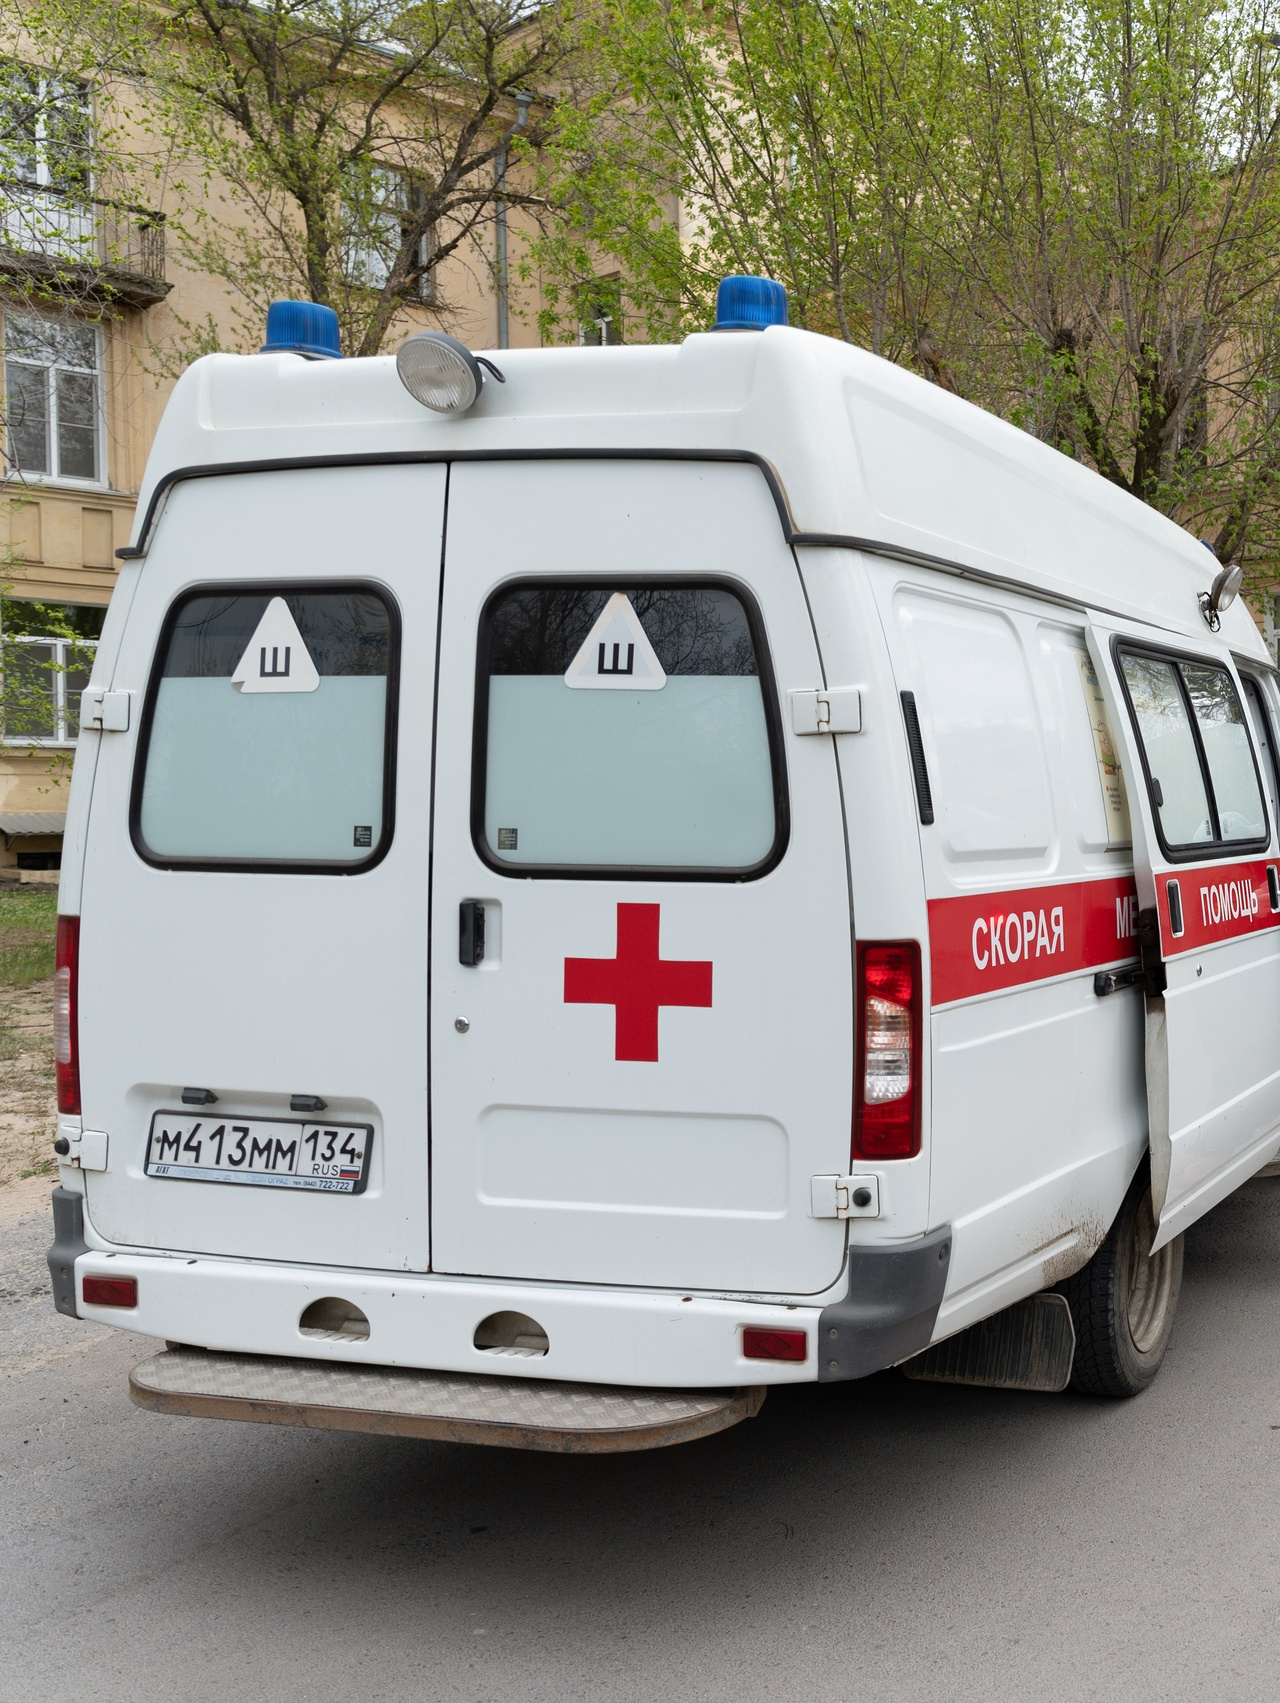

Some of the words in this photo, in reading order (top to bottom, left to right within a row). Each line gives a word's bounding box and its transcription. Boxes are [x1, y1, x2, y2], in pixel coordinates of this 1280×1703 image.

[259, 647, 291, 678] Ш
[598, 643, 635, 675] Ш
[972, 906, 1065, 970] СКОРАЯ
[1200, 878, 1259, 927] ПОМОЩЬ
[159, 1123, 298, 1171] М413ММ
[305, 1130, 356, 1164] 134
[155, 1165, 170, 1175] АГАТ
[319, 1180, 350, 1190] 722-722
[312, 1164, 339, 1176] RUS
